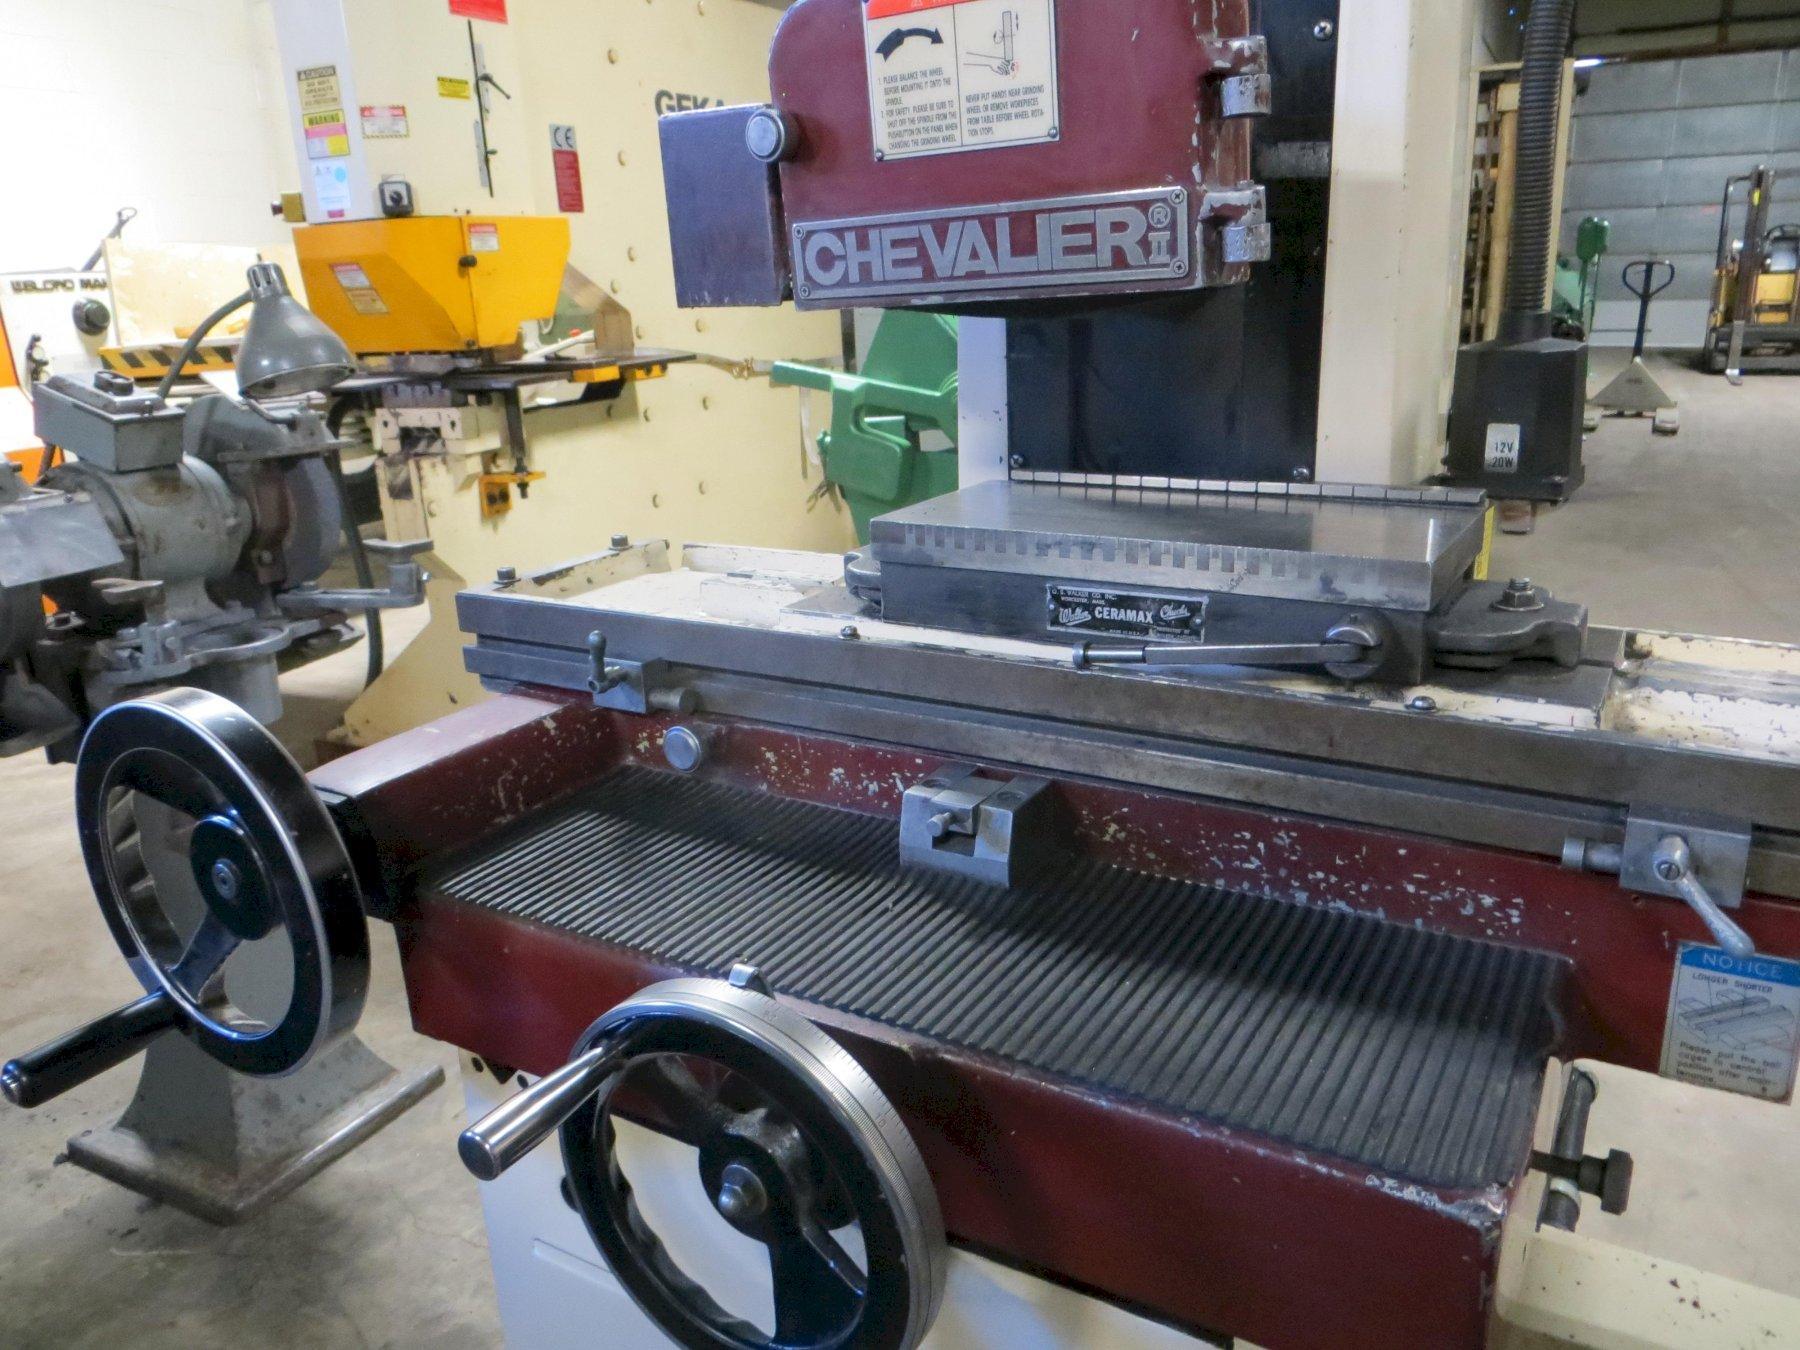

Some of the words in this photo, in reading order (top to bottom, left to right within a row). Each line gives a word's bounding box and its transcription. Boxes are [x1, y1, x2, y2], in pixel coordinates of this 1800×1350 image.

[883, 75, 898, 84] PLEASE
[900, 72, 918, 82] BALANCE
[900, 82, 924, 92] MOUNTING
[942, 77, 951, 86] THE
[966, 93, 980, 103] NEVER
[981, 92, 990, 101] PUT
[992, 90, 1007, 100] HANDS
[1008, 88, 1020, 98] NEAR
[1022, 84, 1044, 96] GRINDING
[912, 104, 928, 113] PLEASE
[936, 100, 946, 110] SURE
[966, 105, 981, 114] WHEEL
[990, 102, 1008, 112] REMOVE
[1010, 98, 1039, 109] WORKPIECES
[308, 113, 340, 126] WARNING
[917, 114, 934, 124] SPINDLE
[936, 112, 948, 121] FROM
[948, 111, 957, 120] THE
[966, 116, 980, 126] FROM
[981, 114, 994, 124] TABLE
[996, 112, 1012, 122] BEFORE
[1014, 110, 1030, 120] WHEEL
[931, 124, 944, 133] PANEL
[944, 122, 958, 131] WHEN
[553, 126, 574, 148] CE
[888, 140, 910, 150] CHANGING
[921, 136, 940, 146] GRINDING
[804, 206, 1147, 287] CHEVALIER
[1495, 441, 1514, 454] 12V
[1492, 456, 1514, 468] 20W
[1094, 606, 1154, 624] CERAMAX
[1703, 952, 1782, 978] NOTICE
[1692, 973, 1728, 985] LONGER
[1734, 980, 1773, 993] SHORTER
[1680, 1040, 1711, 1054] Please
